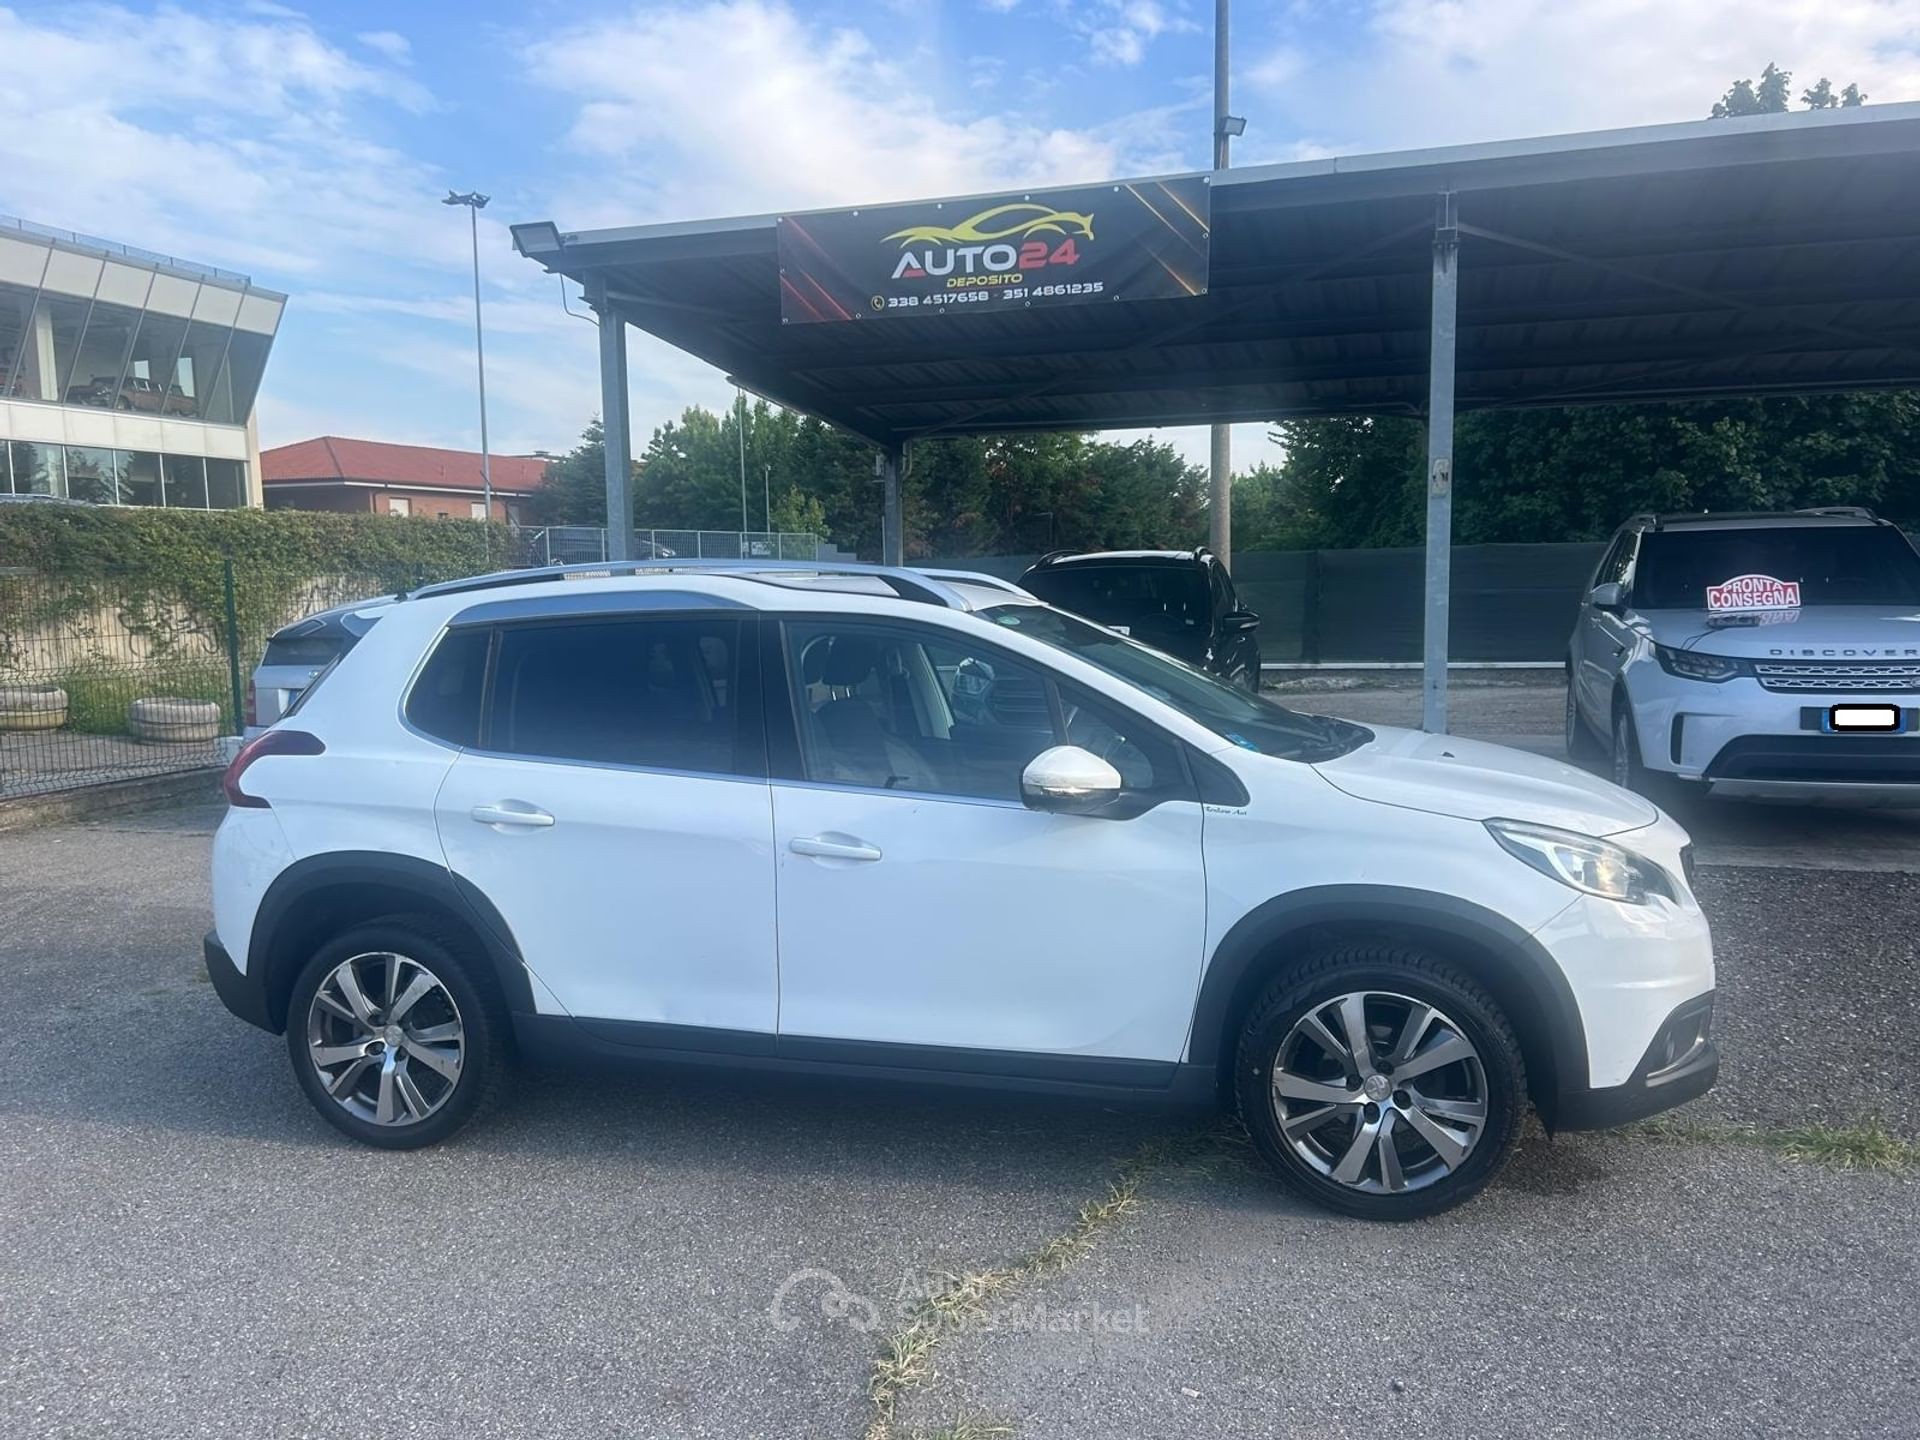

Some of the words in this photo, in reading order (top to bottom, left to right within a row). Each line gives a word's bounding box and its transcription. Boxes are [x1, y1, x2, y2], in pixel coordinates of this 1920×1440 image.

[891, 238, 1080, 279] AUTO24
[946, 273, 1023, 288] DEPOSITO
[888, 297, 919, 308] 338
[923, 291, 989, 305] 4517658
[1003, 288, 1029, 300] 351
[1032, 282, 1104, 297] 4861235
[1723, 578, 1783, 593] PRONTA
[1710, 588, 1797, 608] CONSEGNA
[1769, 649, 1919, 657] DISCOVER
